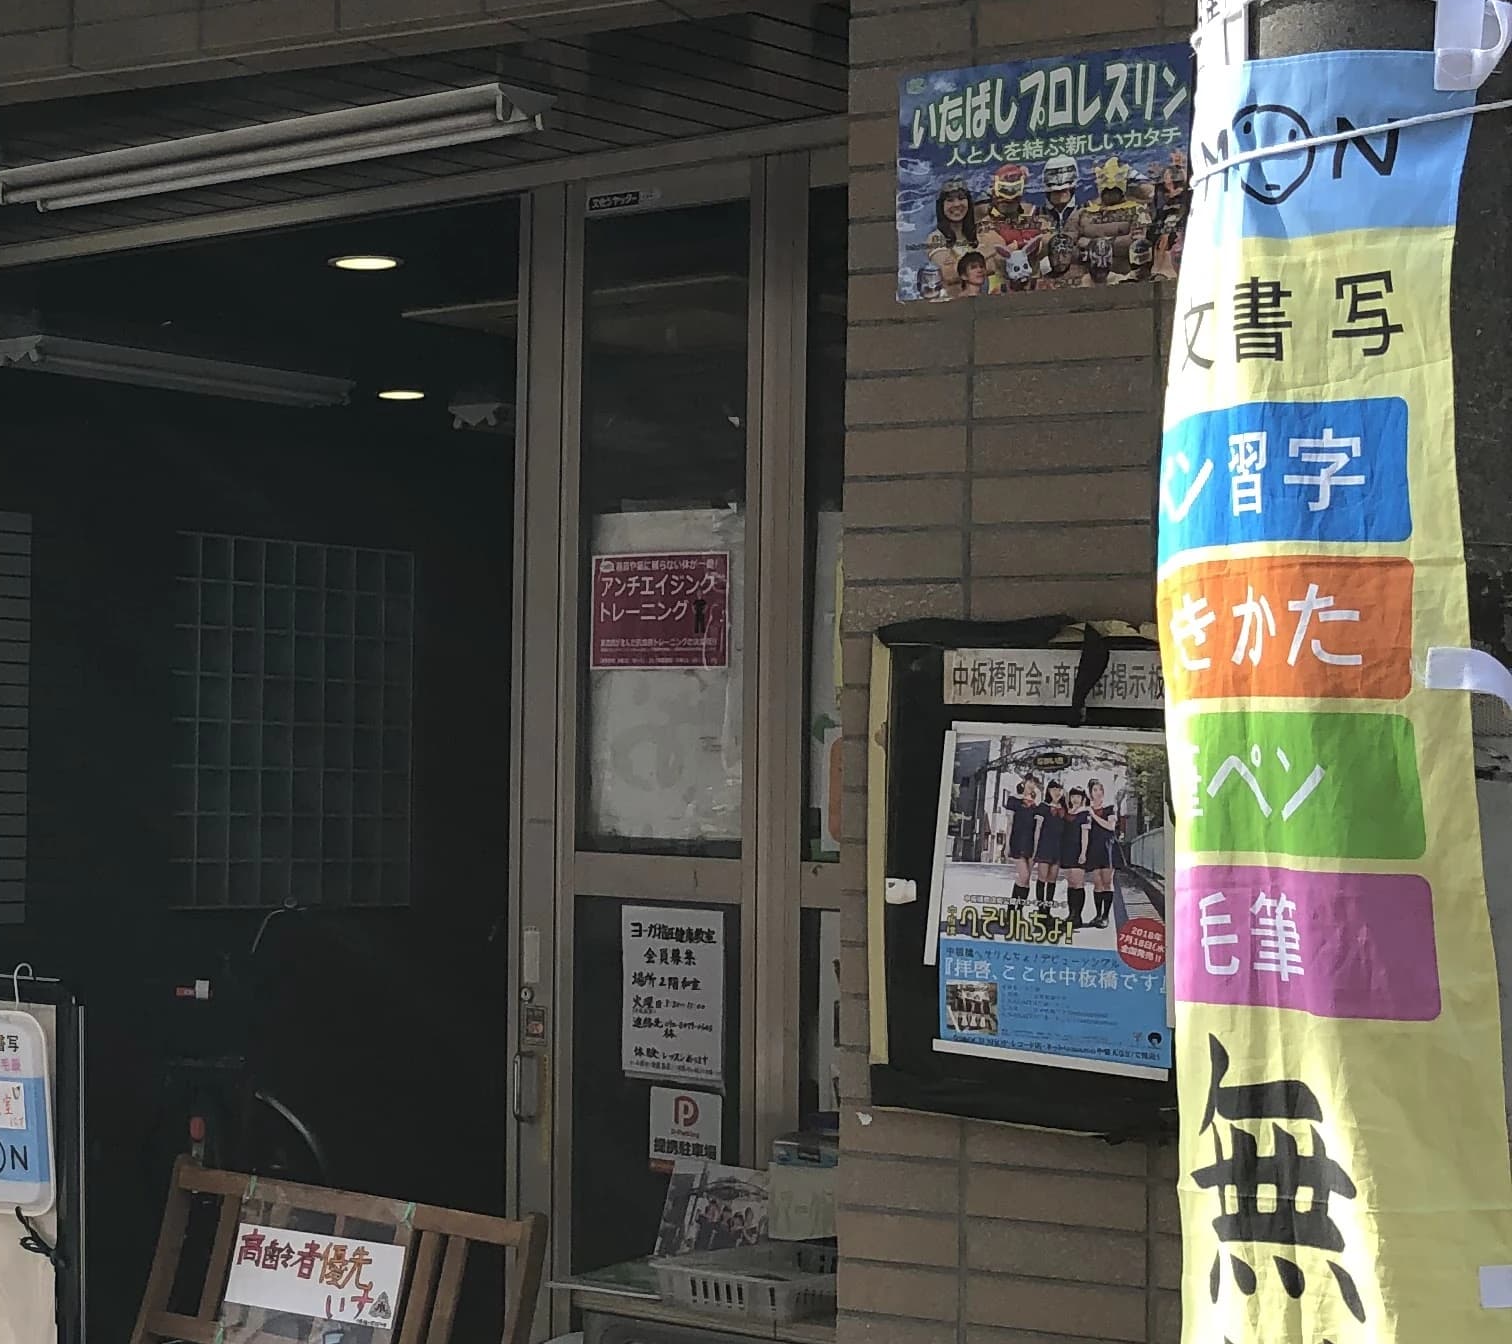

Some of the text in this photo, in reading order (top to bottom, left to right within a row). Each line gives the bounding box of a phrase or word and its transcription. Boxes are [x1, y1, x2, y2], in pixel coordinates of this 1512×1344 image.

[947, 127, 1182, 167] 人と人を結ぶ新しいカタチ
[600, 572, 716, 597] アンチエイジング
[600, 599, 689, 623] トレーニング
[952, 661, 1165, 701] 中板橋町会・商街掲示板
[1188, 745, 1326, 821] ペン
[1130, 926, 1163, 942] 2018年
[1199, 891, 1305, 981] 毛筆
[236, 1227, 374, 1290] 高齢者優先
[325, 1288, 375, 1321] いす
